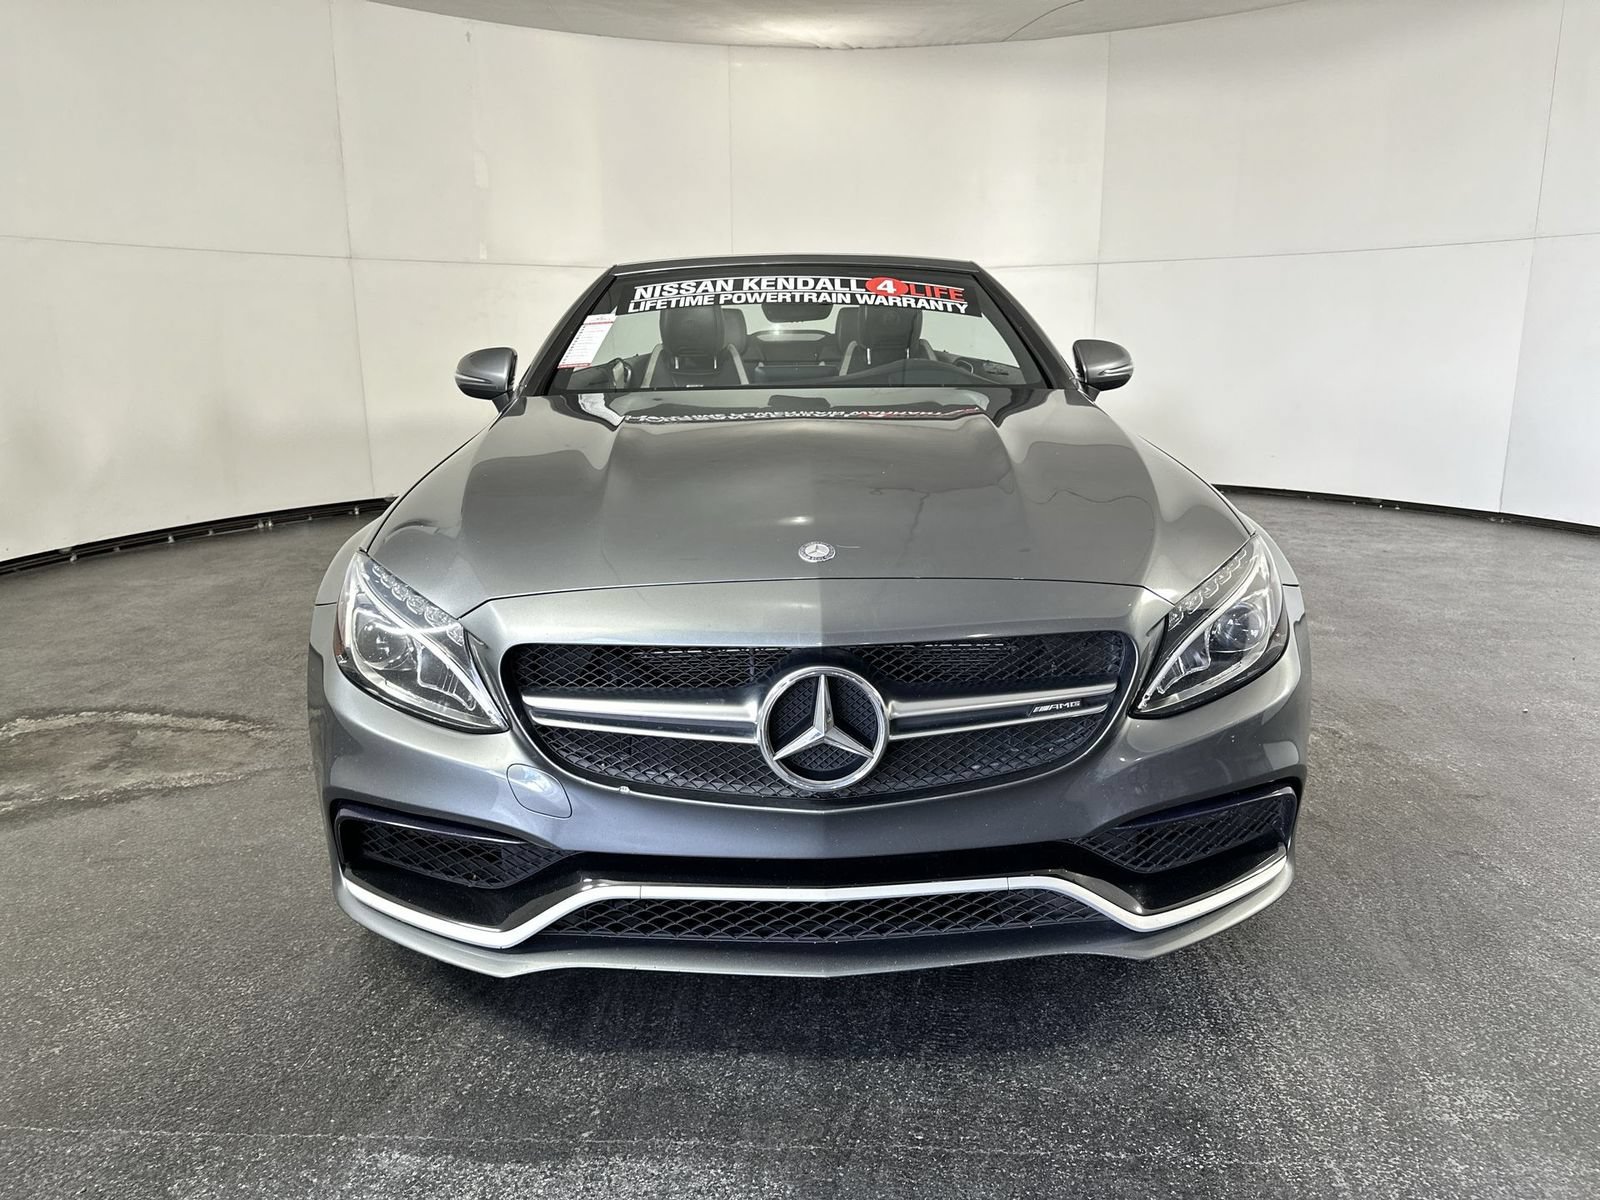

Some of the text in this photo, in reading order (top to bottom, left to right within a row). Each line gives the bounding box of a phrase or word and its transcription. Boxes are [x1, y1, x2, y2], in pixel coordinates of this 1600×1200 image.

[634, 277, 965, 302] NISSAN KENDALL 4 LIFE
[627, 292, 969, 314] LIFETIME POWERTRAIN WARRANTY
[1047, 700, 1081, 710] AMG
